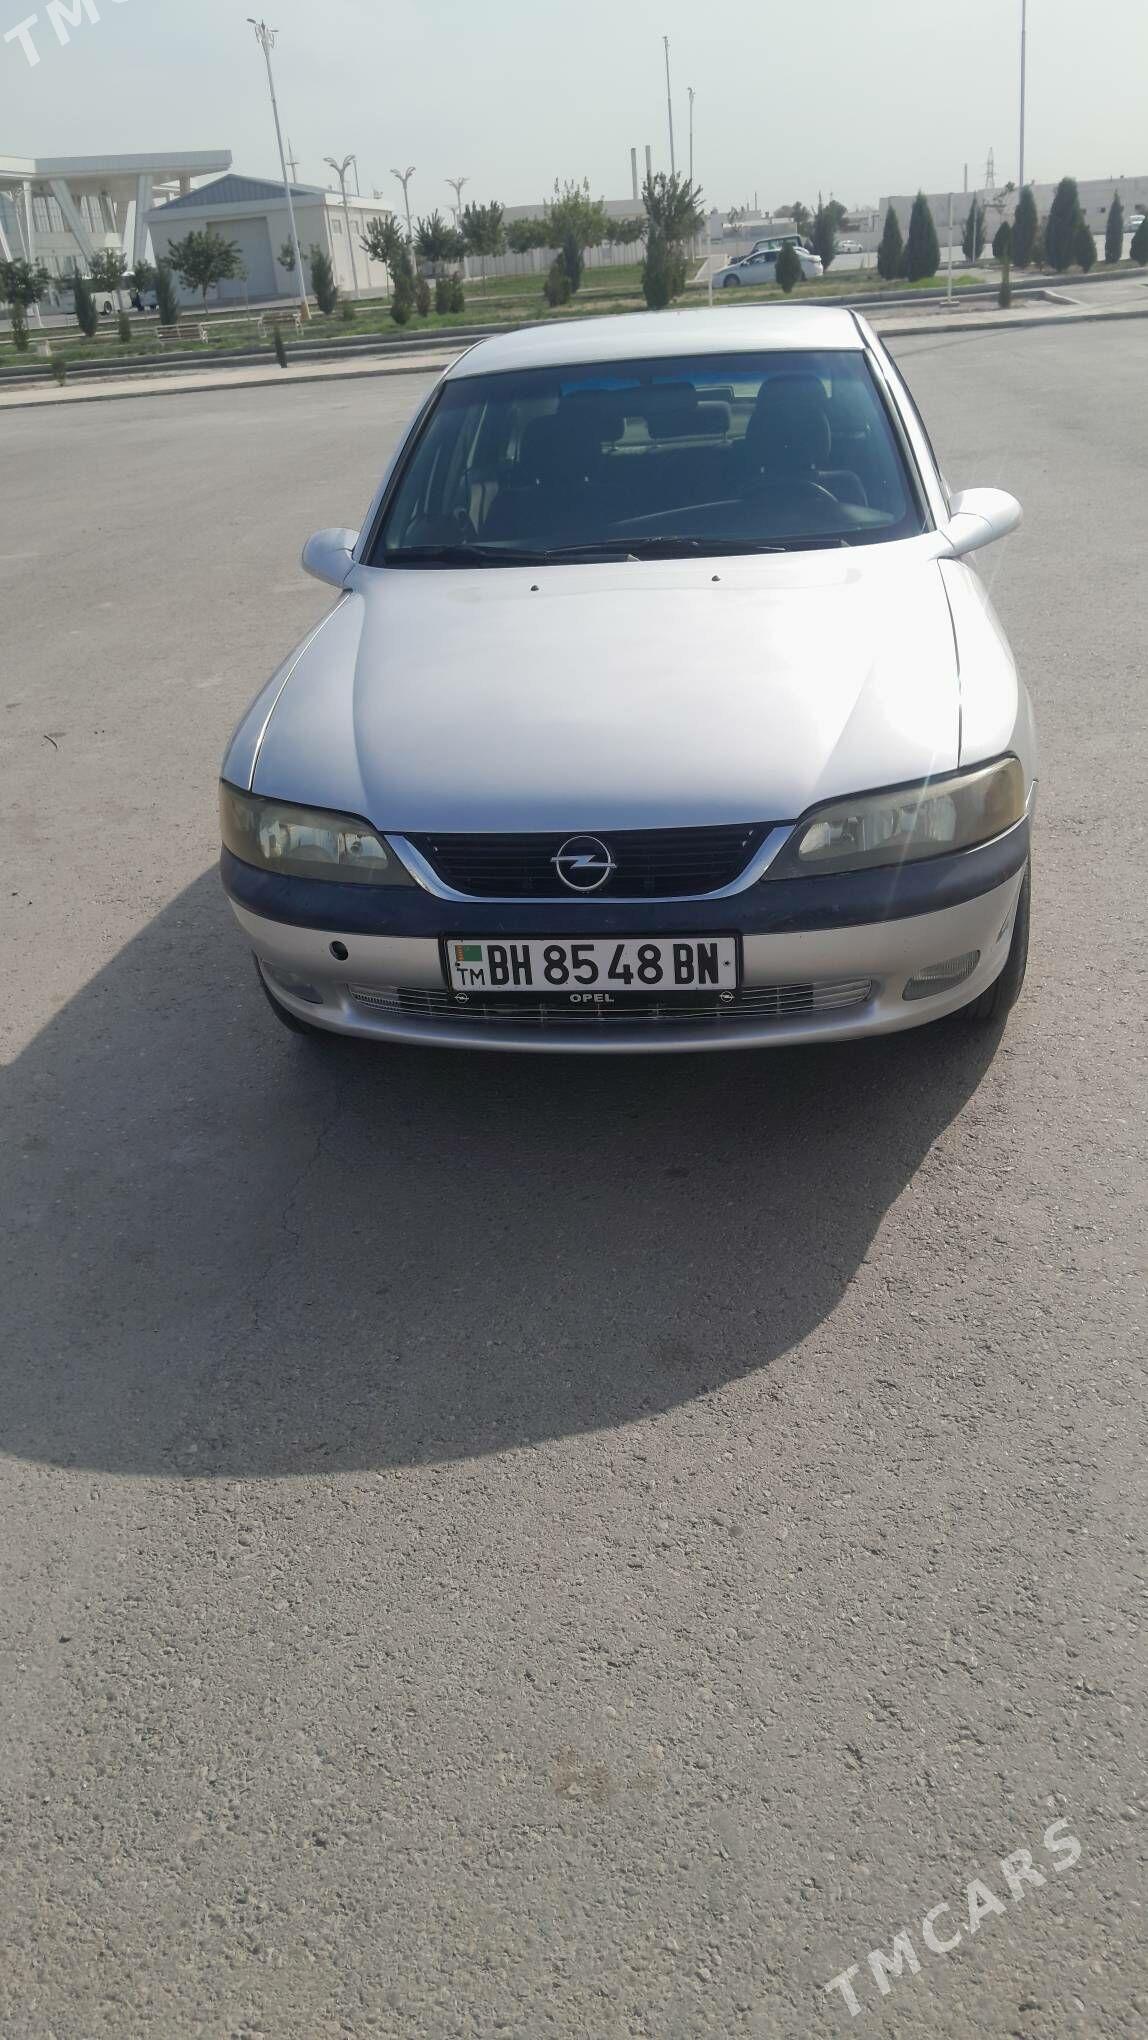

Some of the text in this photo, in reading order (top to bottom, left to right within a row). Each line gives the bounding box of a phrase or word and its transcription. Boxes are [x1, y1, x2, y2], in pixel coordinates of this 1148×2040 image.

[487, 944, 533, 986] BH
[673, 943, 719, 985] BN
[456, 968, 485, 986] TM
[569, 993, 615, 1003] OPEL
